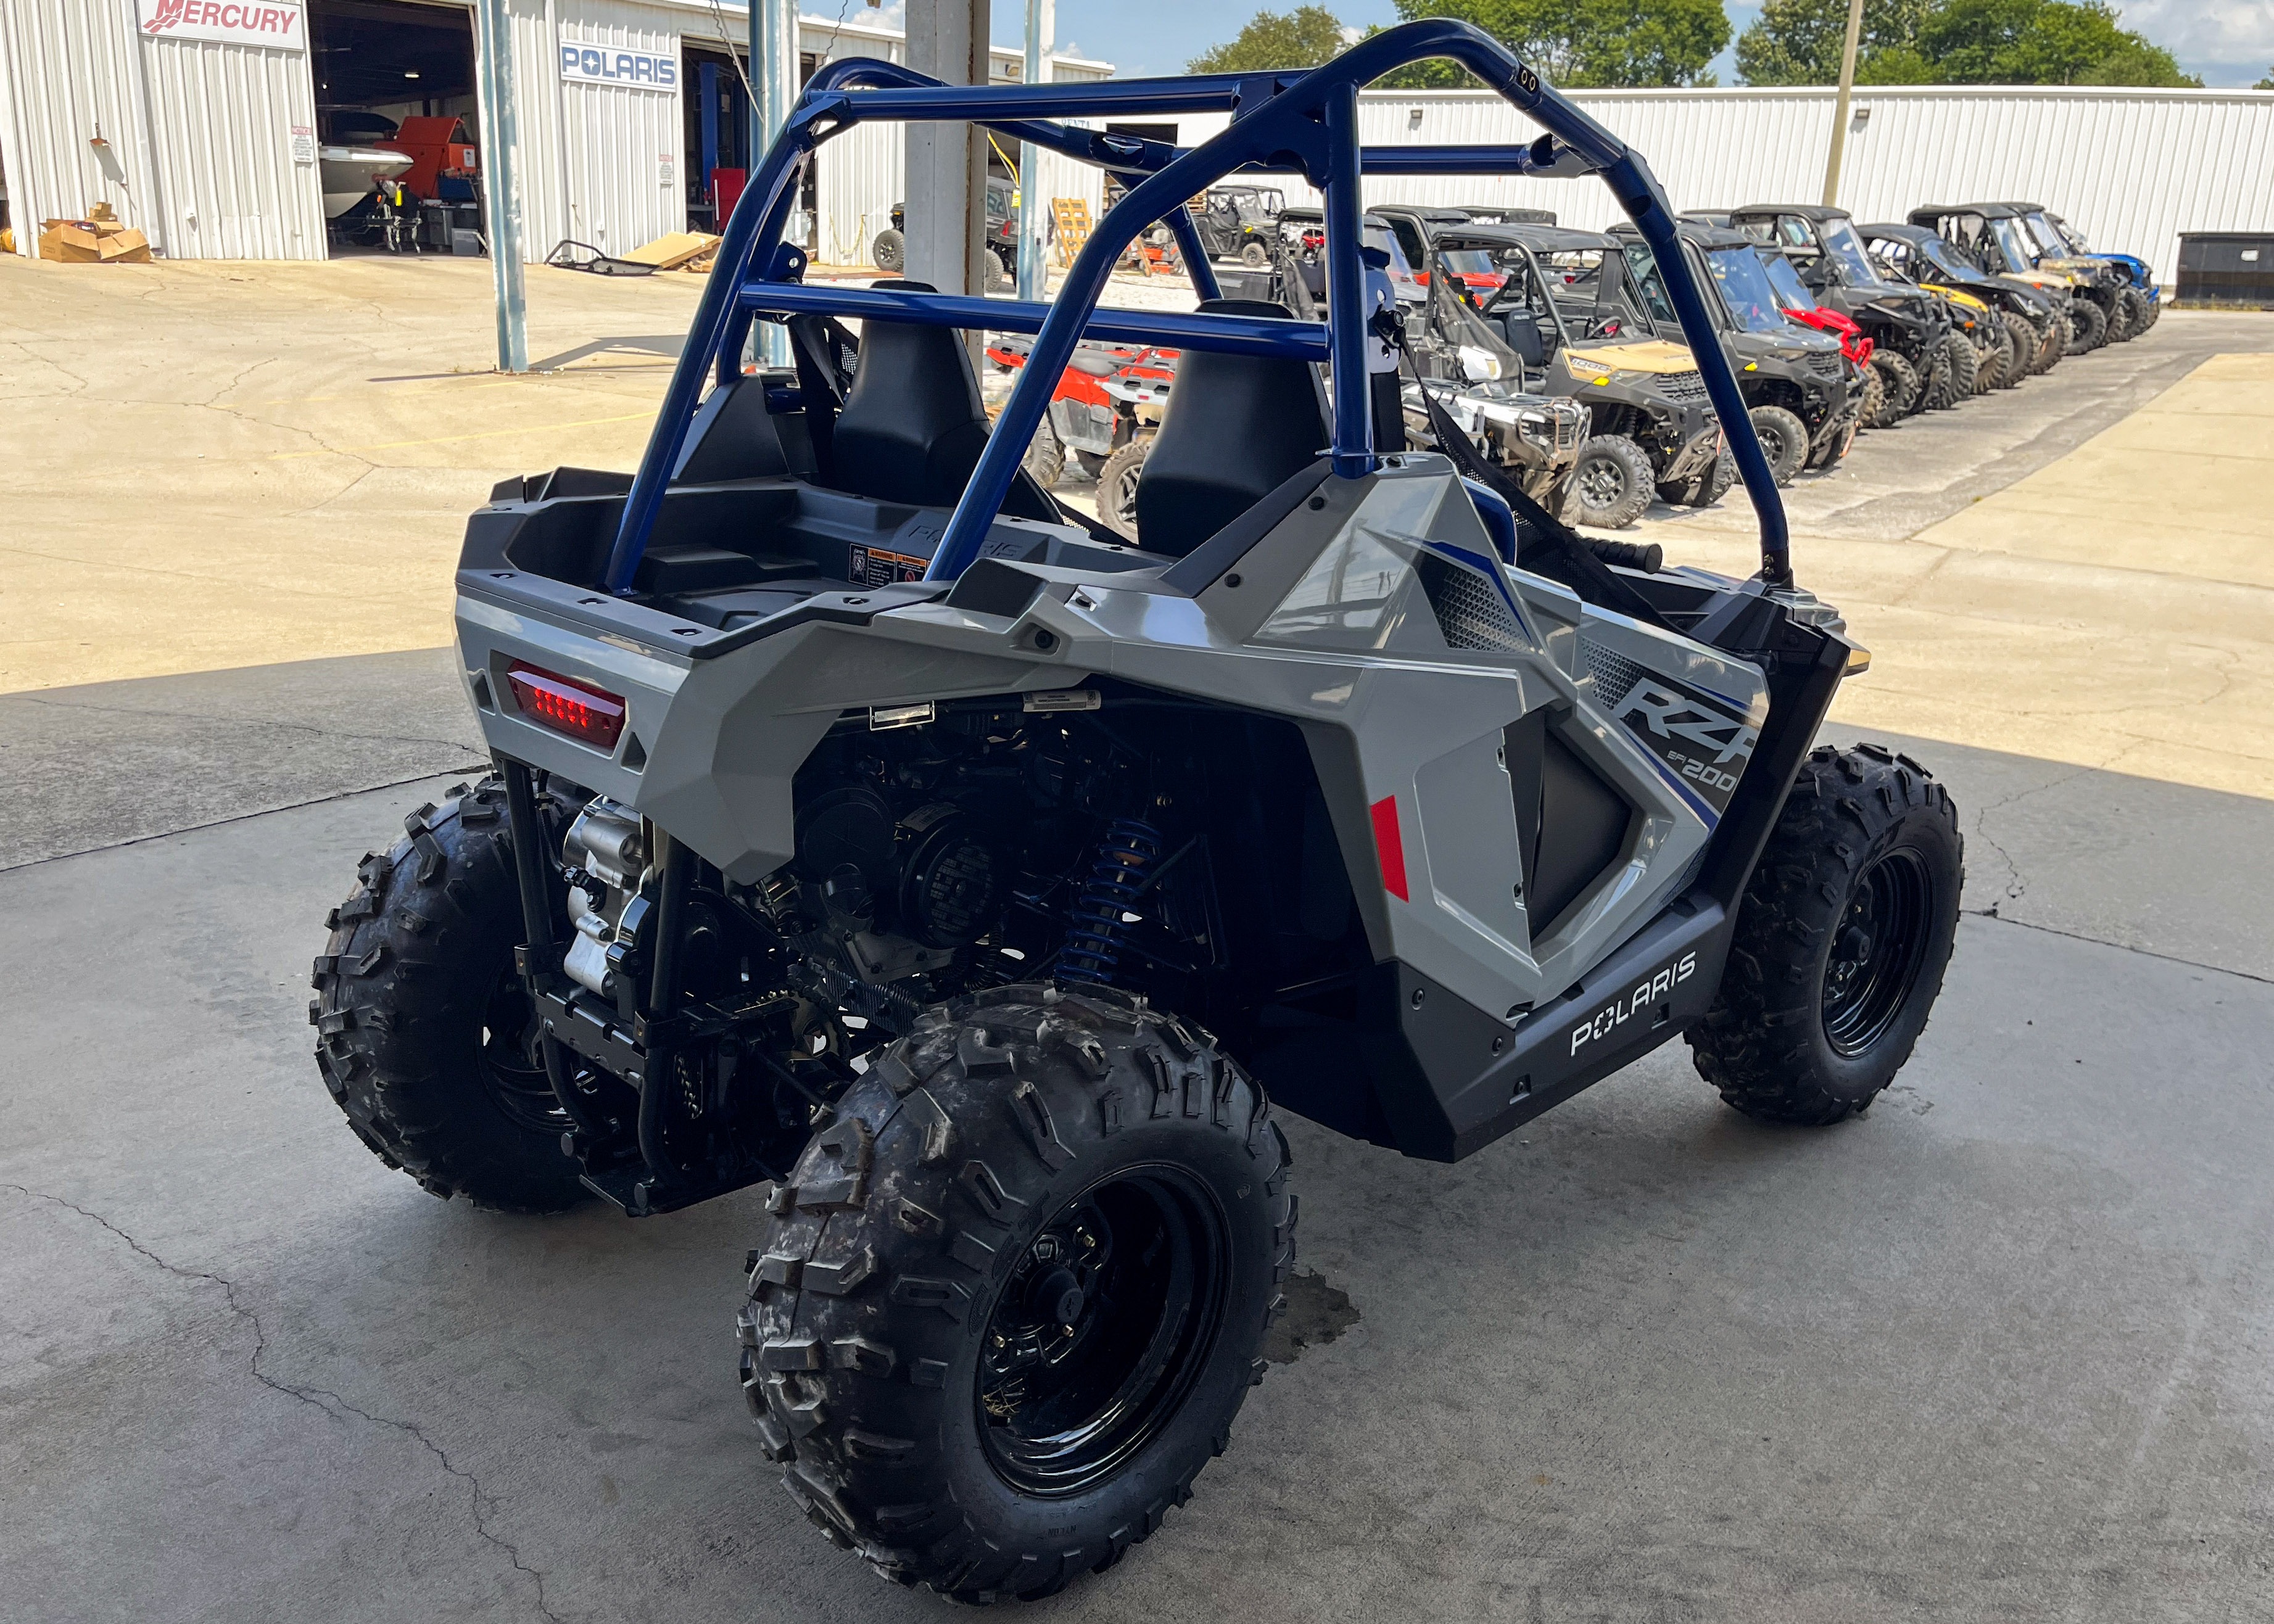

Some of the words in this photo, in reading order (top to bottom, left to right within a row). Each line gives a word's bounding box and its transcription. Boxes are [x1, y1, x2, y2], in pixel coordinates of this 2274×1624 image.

[150, 0, 296, 34] MERCURY
[561, 46, 674, 84] POLARIS
[1667, 750, 1686, 764] EFI
[1682, 759, 1737, 792] 200
[1571, 950, 1696, 1057] POLARIS
